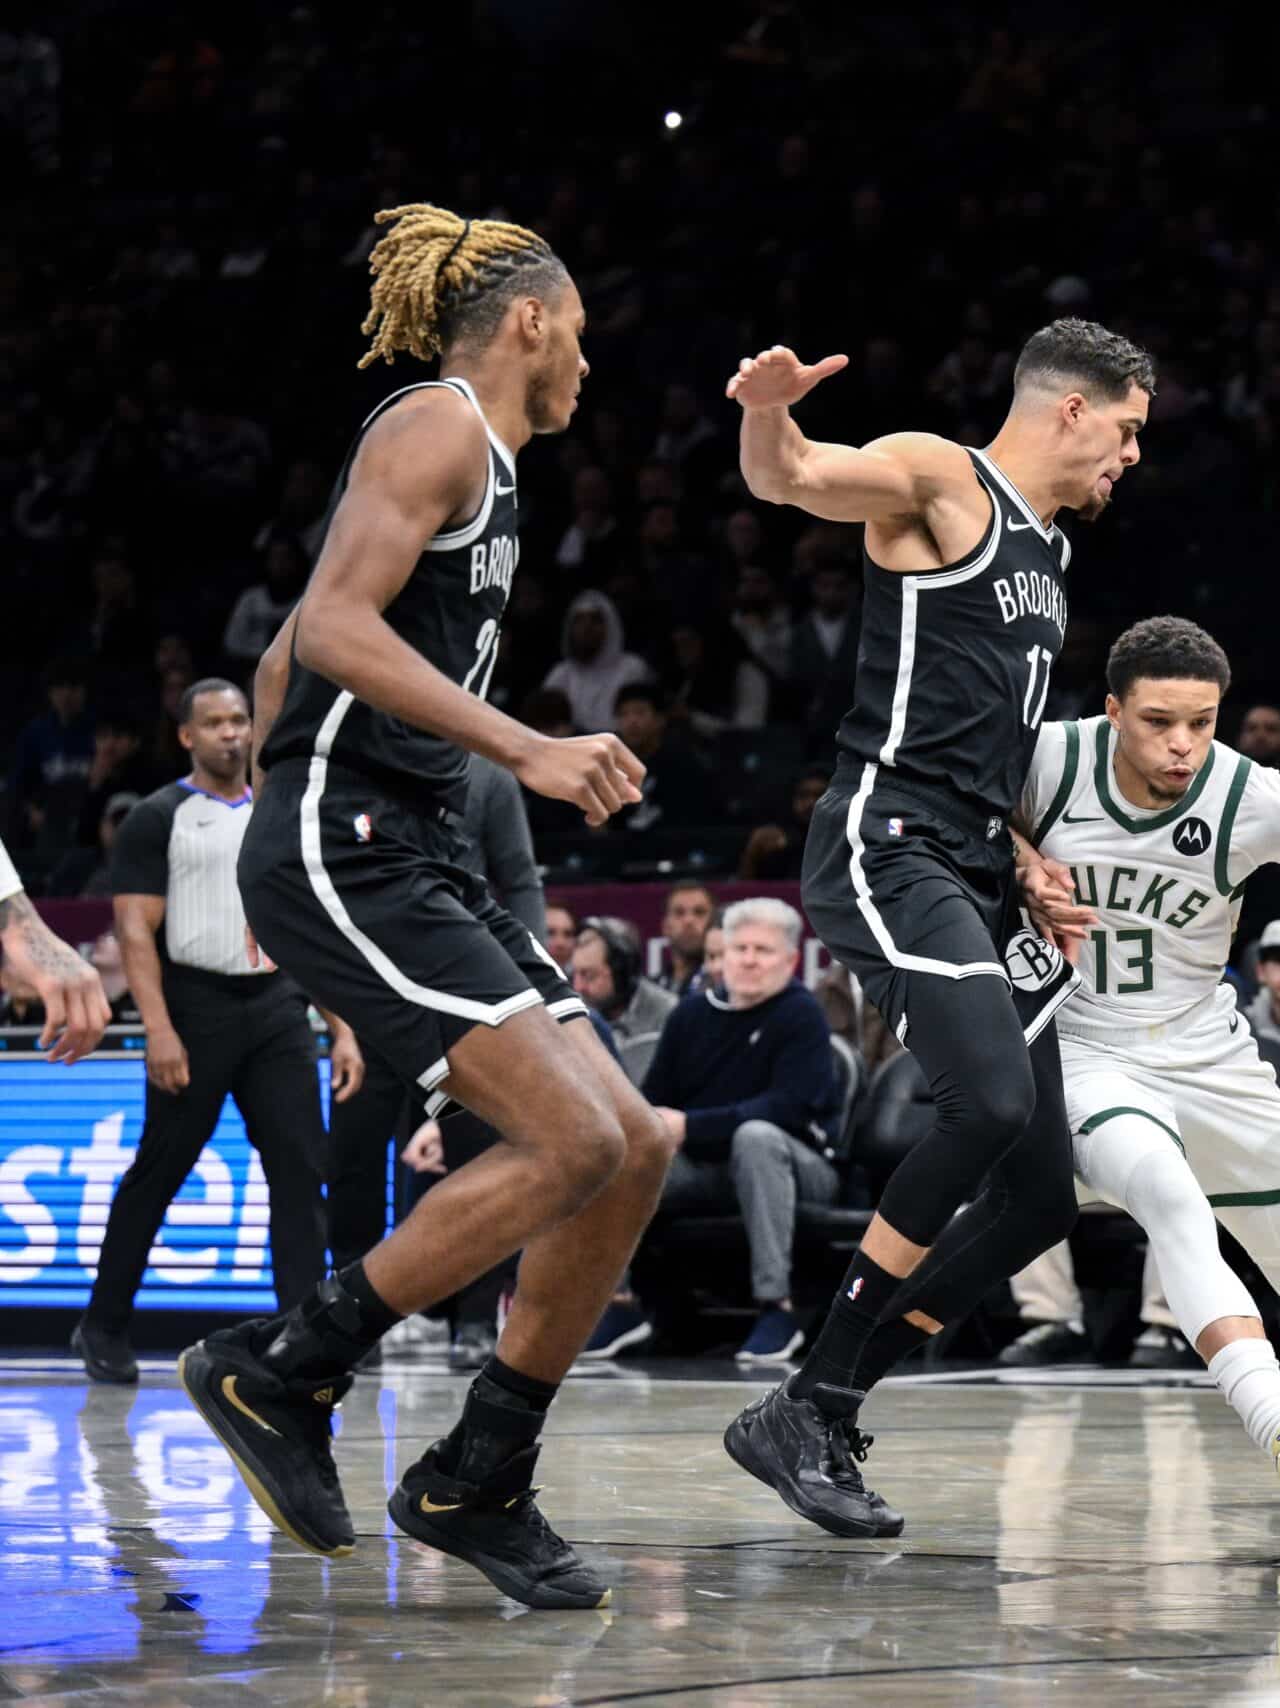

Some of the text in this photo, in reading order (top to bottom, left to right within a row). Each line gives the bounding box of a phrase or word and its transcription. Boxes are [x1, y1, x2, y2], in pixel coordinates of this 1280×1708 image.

[1068, 865, 1211, 929] UCKS
[1016, 937, 1052, 982] B
[1091, 928, 1153, 995] 13
